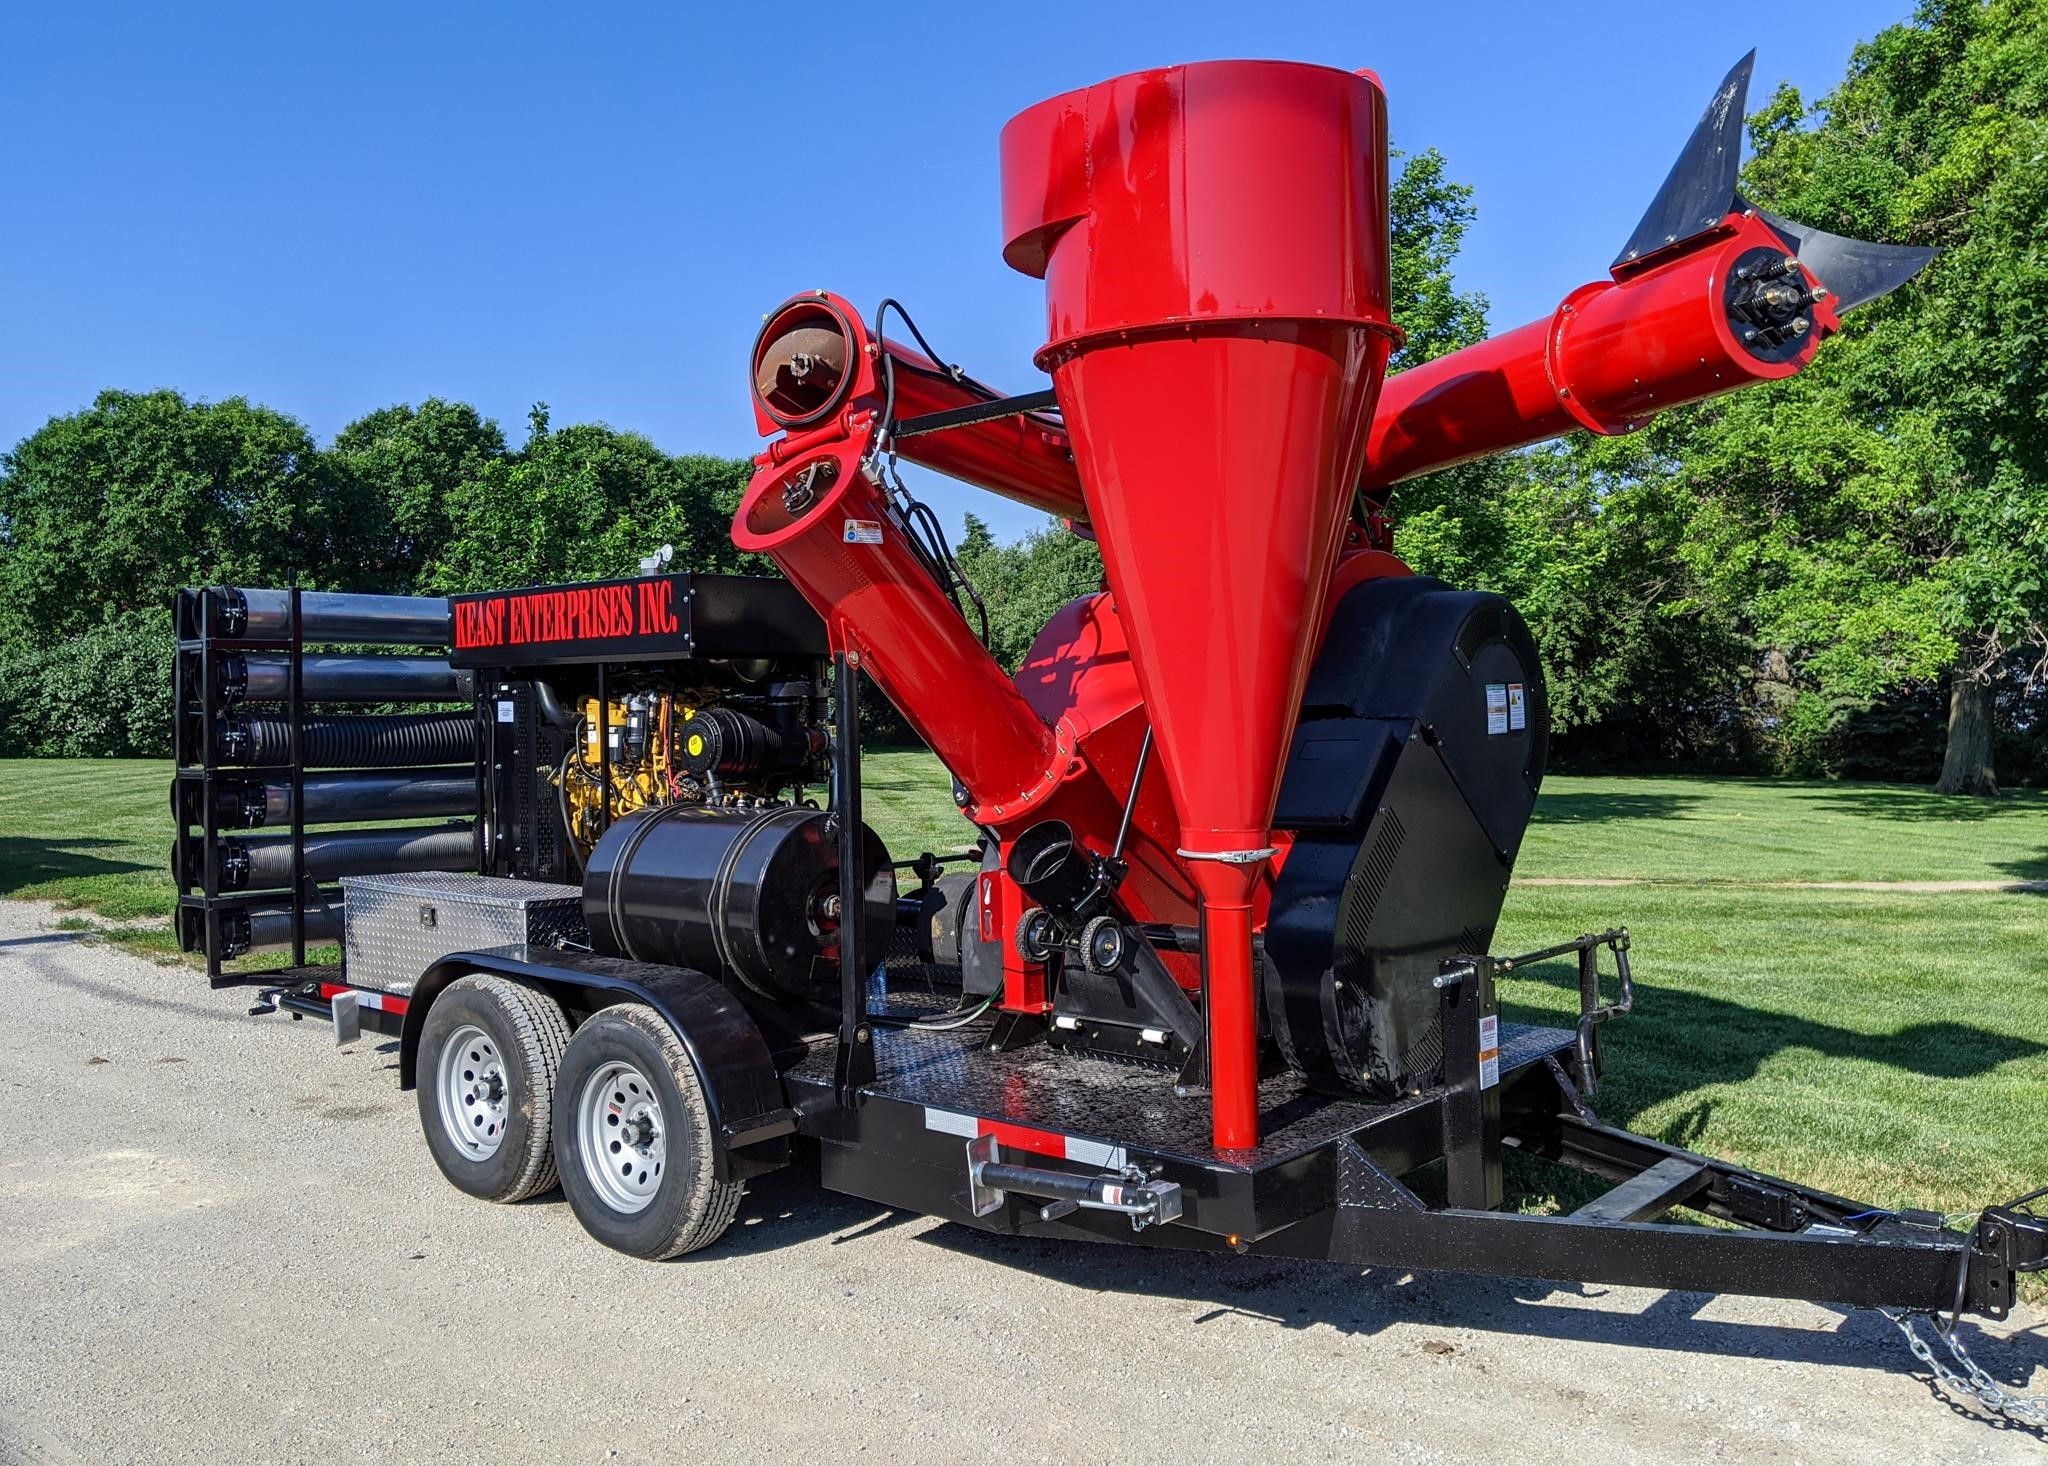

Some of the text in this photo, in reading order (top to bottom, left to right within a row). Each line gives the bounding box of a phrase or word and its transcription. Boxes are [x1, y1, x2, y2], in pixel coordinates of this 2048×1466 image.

[454, 580, 678, 649] KEAST ENTERPRISES INC.
